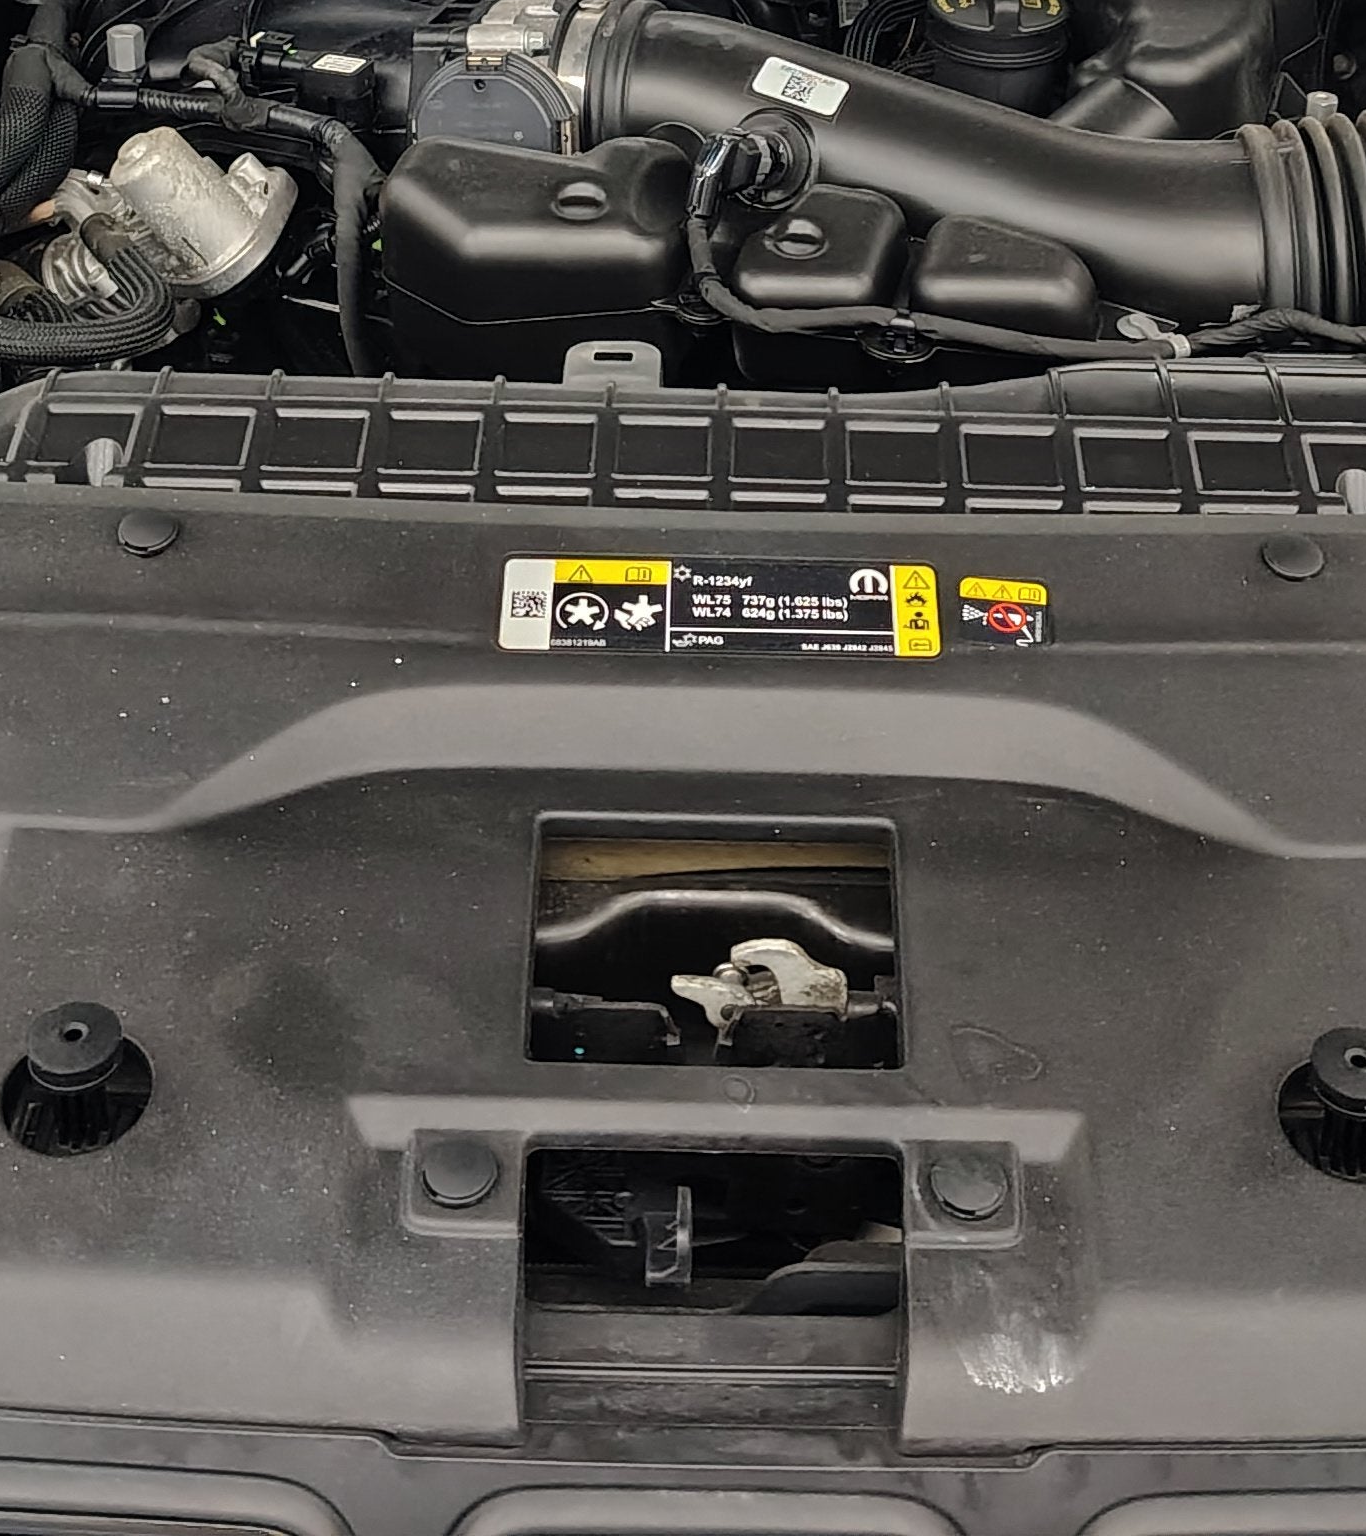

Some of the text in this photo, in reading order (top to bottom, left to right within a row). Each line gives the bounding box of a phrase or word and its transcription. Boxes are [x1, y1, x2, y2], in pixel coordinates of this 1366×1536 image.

[692, 575, 754, 588] R-1234yf
[691, 594, 732, 605] WL75
[741, 594, 776, 608] 737g
[821, 595, 849, 608] lbs)
[691, 606, 850, 622] WL74 624g (1.375 lbs)
[698, 635, 725, 646] PAG
